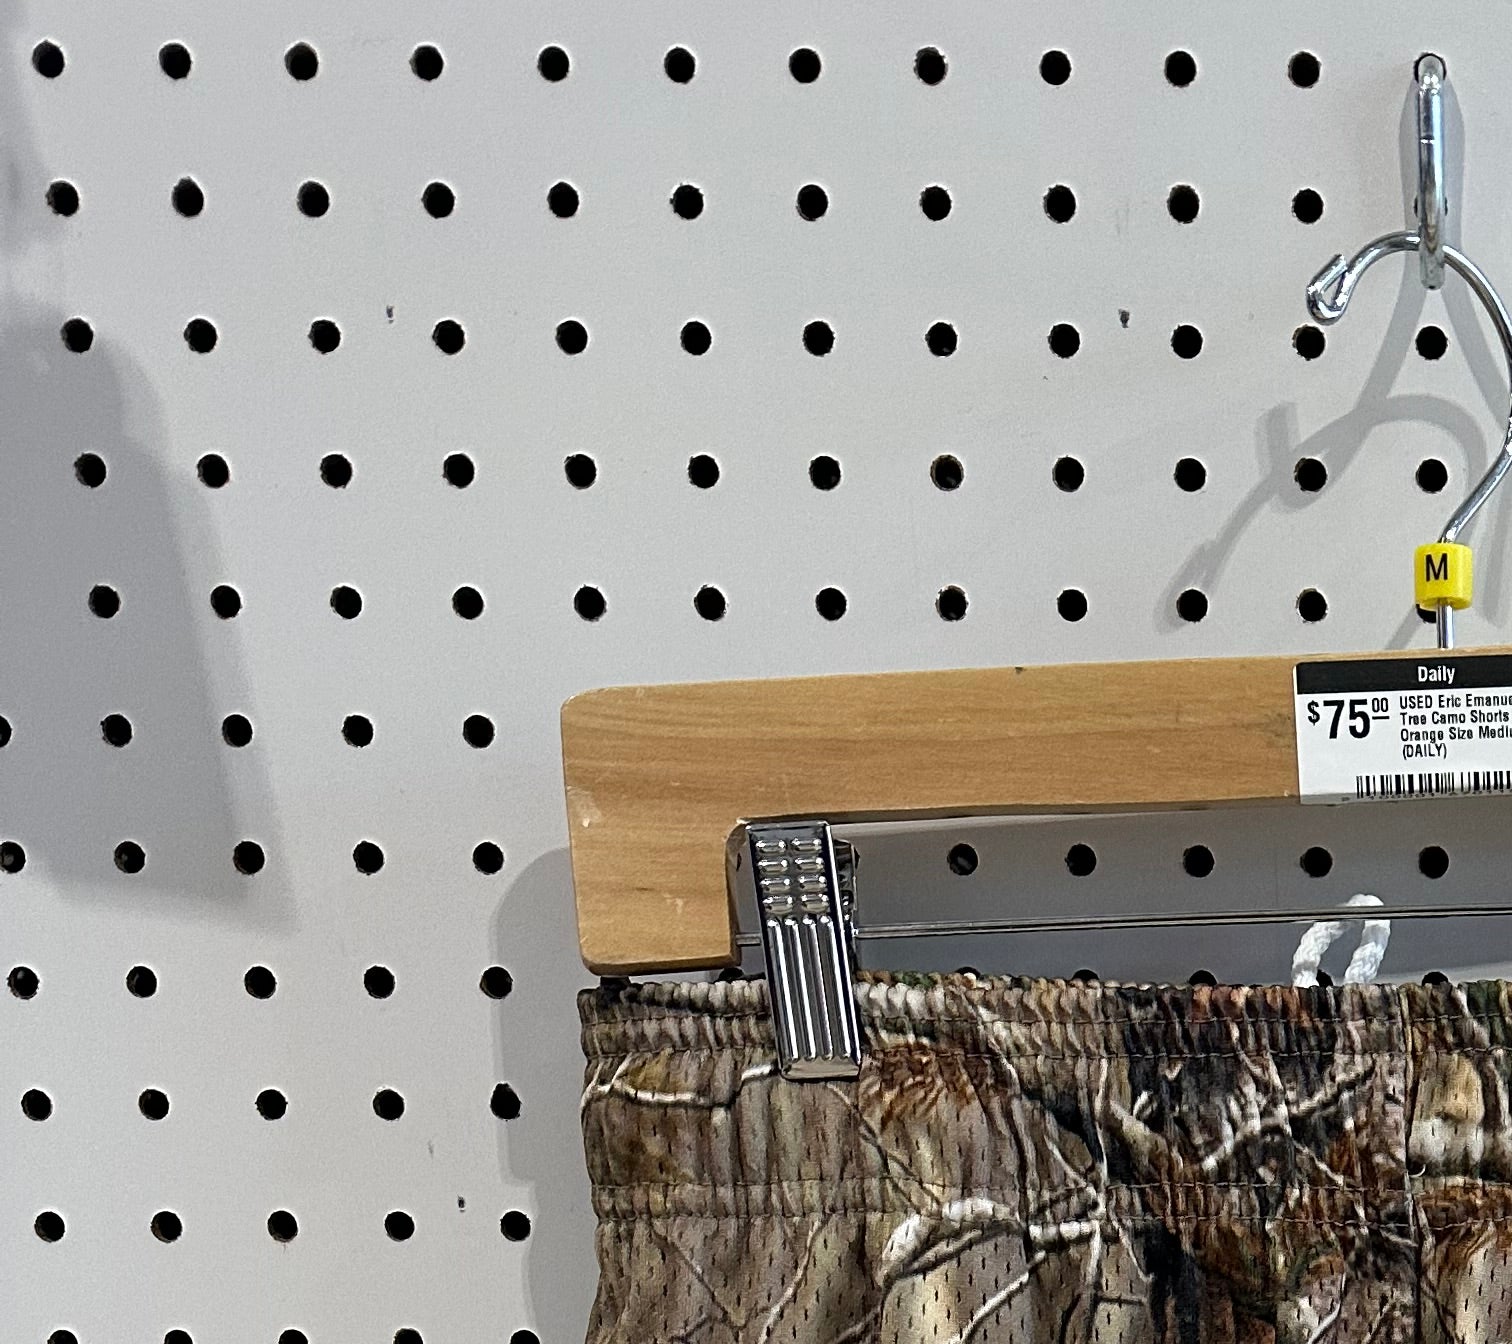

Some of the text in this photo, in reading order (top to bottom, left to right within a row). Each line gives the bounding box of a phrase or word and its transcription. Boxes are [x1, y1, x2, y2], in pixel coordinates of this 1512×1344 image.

[1424, 553, 1449, 583] M
[1417, 665, 1456, 684] Daily
[1399, 694, 1433, 710] USED
[1438, 693, 1462, 708] Eric
[1400, 711, 1427, 725] Tree
[1431, 710, 1467, 725] Camo
[1470, 709, 1510, 724] Shorts
[1400, 727, 1444, 745] Orange
[1448, 726, 1474, 741] Size
[1402, 742, 1448, 760] (DAILY)
